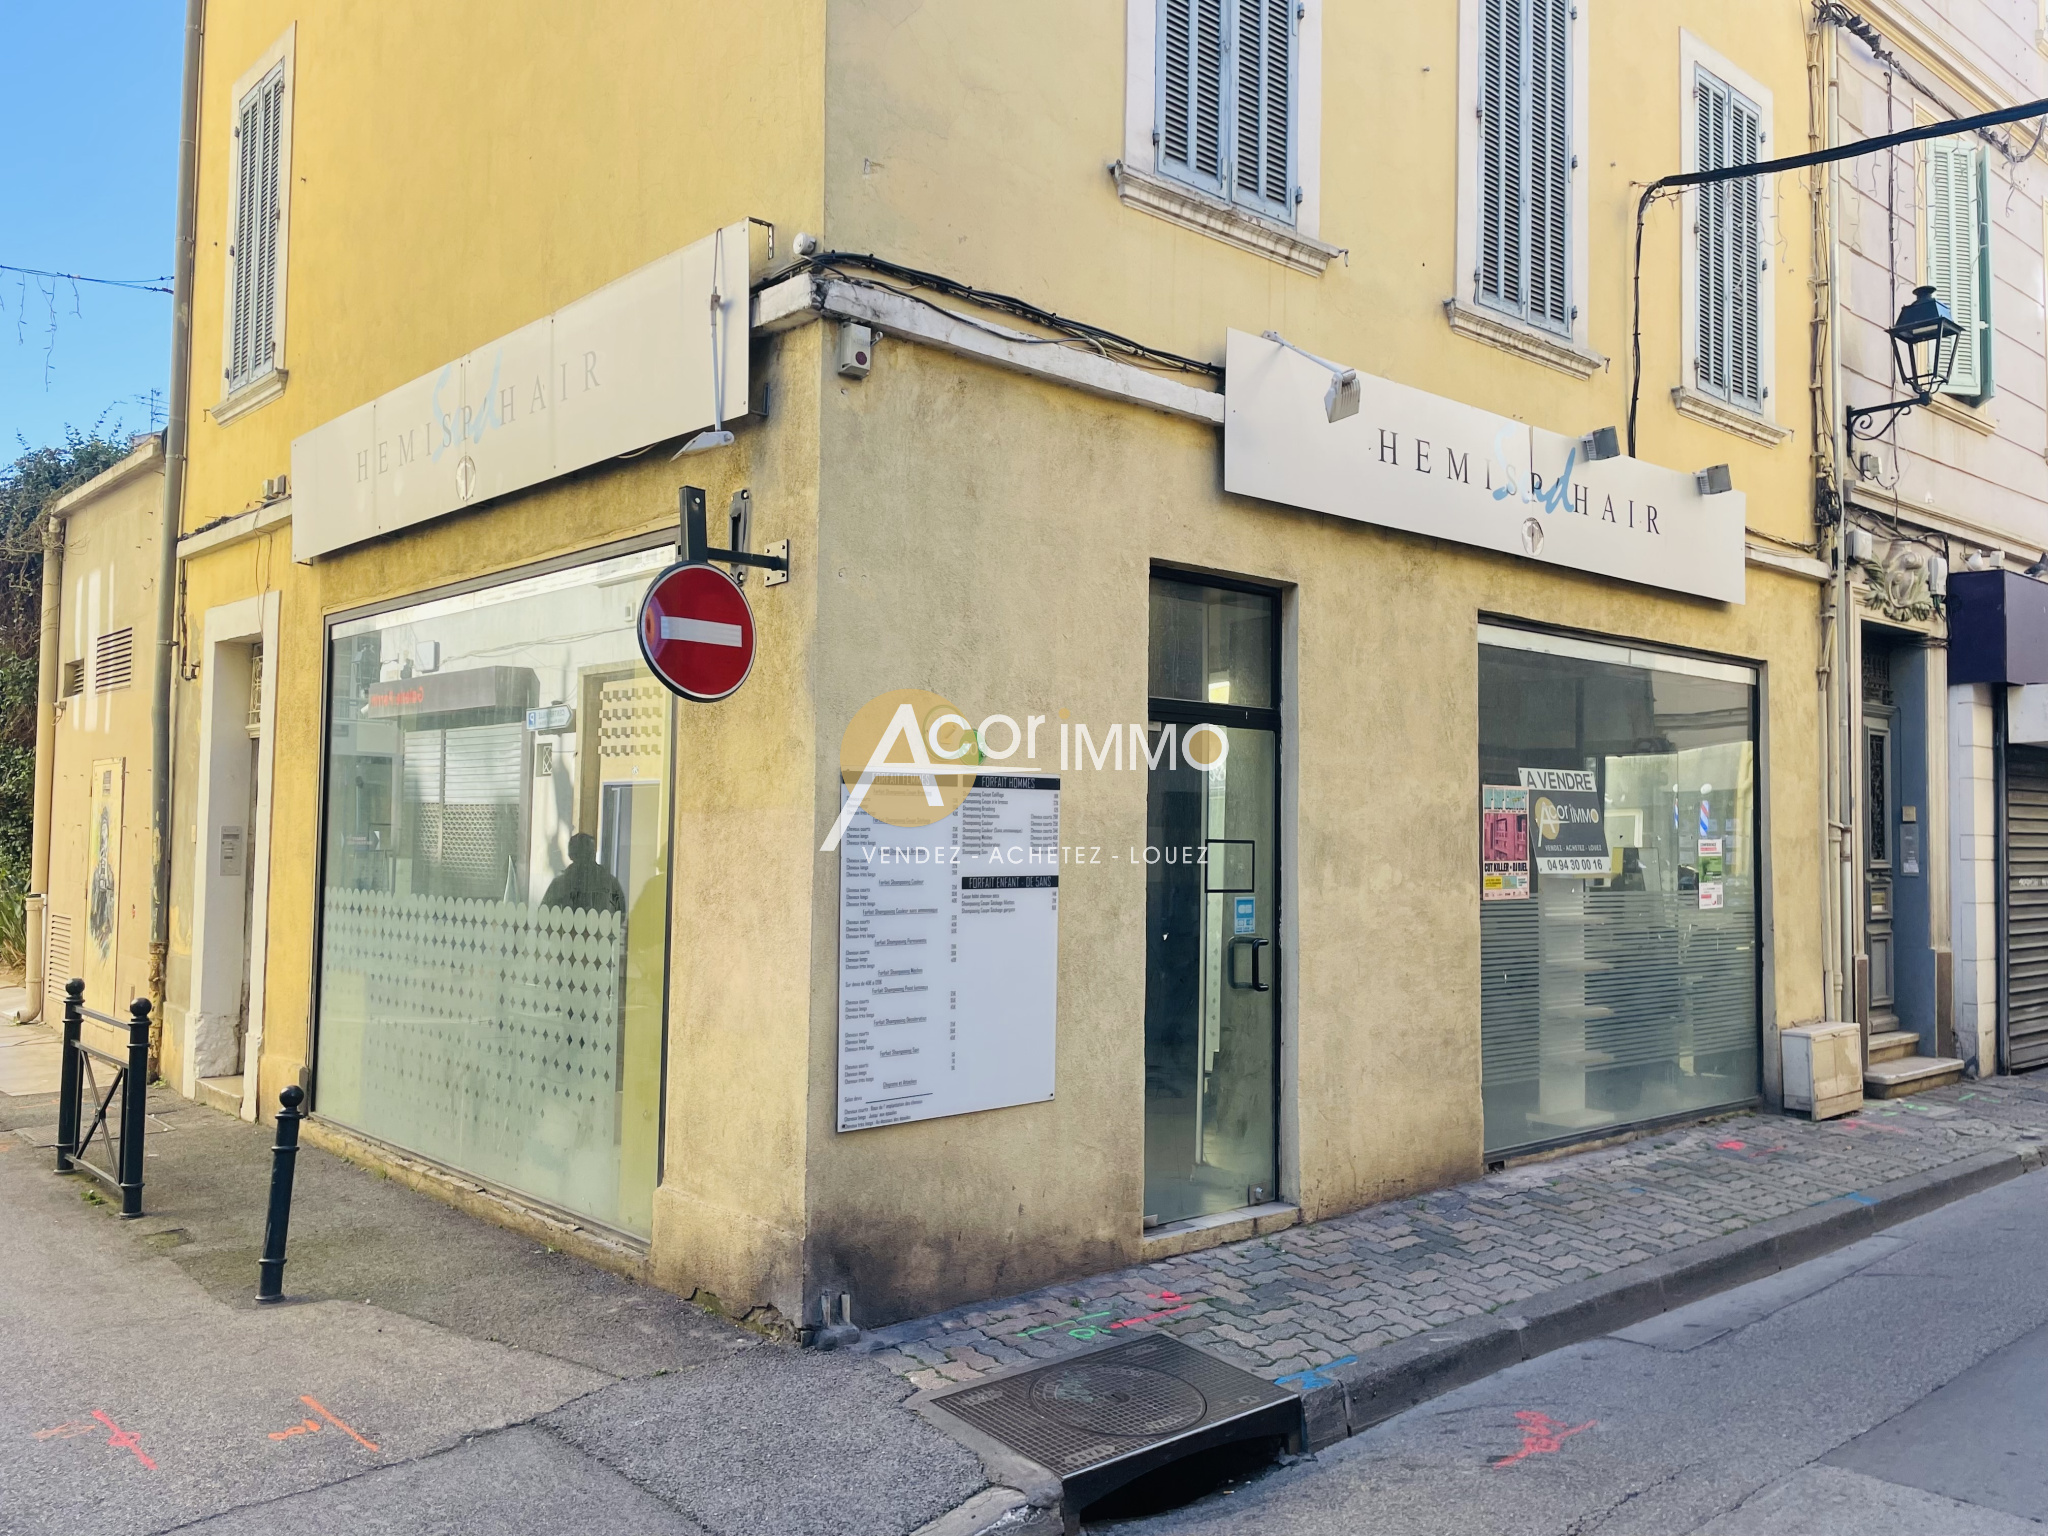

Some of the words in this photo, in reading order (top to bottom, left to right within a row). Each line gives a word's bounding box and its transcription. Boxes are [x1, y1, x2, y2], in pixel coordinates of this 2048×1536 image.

[982, 777, 1007, 787] FORFAIT
[1009, 778, 1035, 788] HOMMES
[1527, 771, 1537, 788] A
[1537, 771, 1593, 790] VENDRE
[1547, 859, 1557, 870] 04
[1560, 859, 1569, 870] 94
[1570, 859, 1580, 870] 30
[1581, 859, 1592, 870] 00
[1593, 859, 1603, 870] 16
[969, 878, 994, 888] FORFAIT
[997, 877, 1019, 887] ENFANT
[1026, 877, 1033, 887] DE
